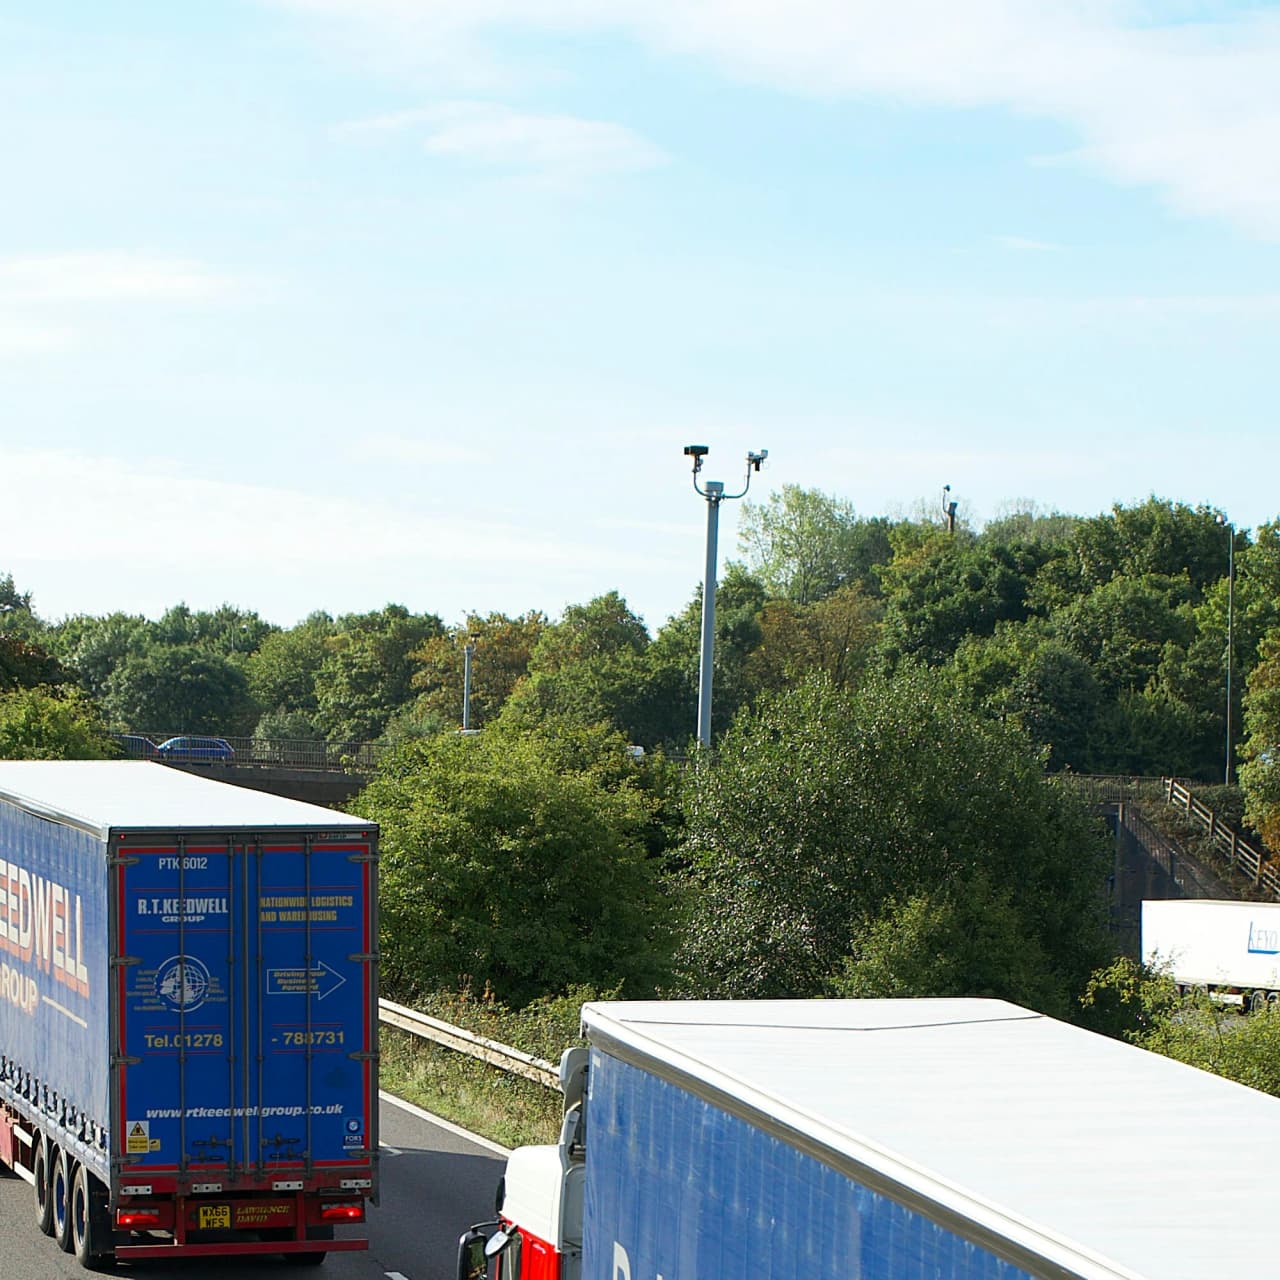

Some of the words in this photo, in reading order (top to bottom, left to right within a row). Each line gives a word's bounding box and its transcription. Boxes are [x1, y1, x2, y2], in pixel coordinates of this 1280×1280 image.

[159, 857, 179, 870] PTK
[183, 857, 208, 869] 6012
[259, 897, 307, 907] NATIONWID
[311, 896, 353, 907] LOGISTICS
[279, 911, 337, 921] WAREHUSING
[202, 1207, 227, 1217] WX66
[206, 1217, 225, 1227] WFS
